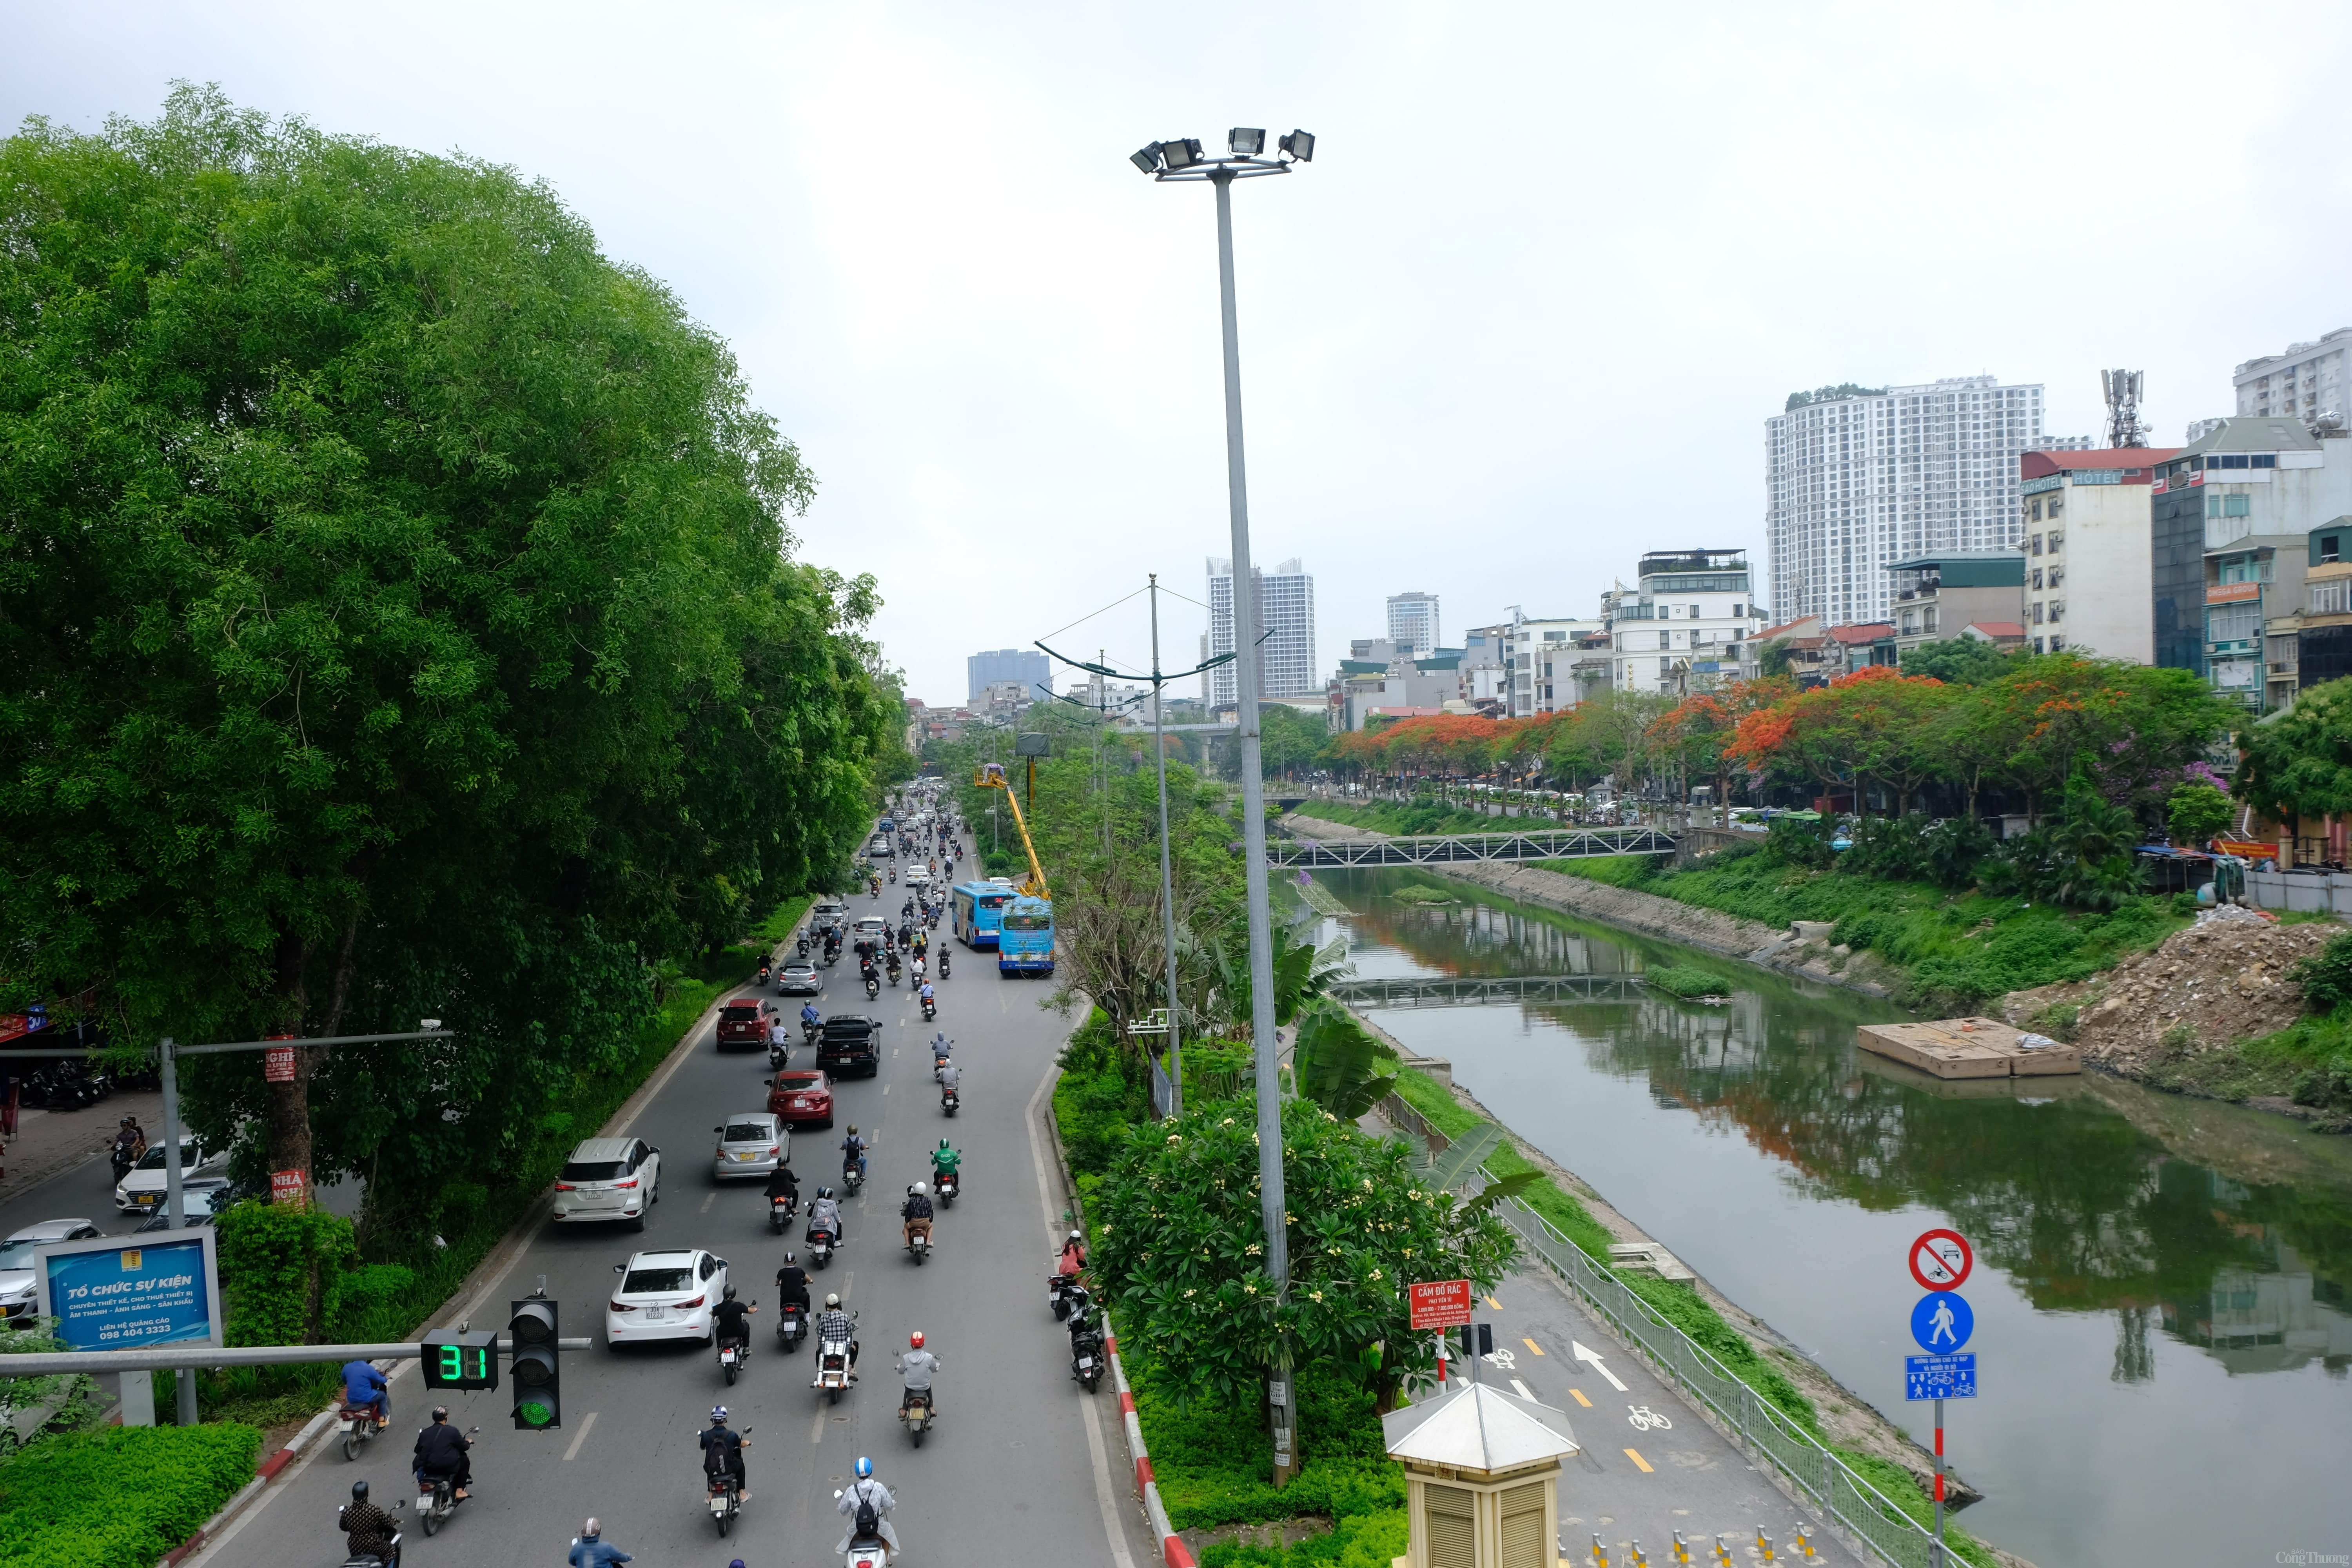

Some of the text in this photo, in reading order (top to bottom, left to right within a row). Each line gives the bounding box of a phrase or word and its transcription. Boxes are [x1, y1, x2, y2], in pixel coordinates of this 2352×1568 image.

[2020, 477, 2060, 494] SAO HOTEL
[2075, 474, 2120, 483] HOTEL
[2207, 584, 2258, 597] OMEGA GROUP
[68, 1274, 192, 1299] TỔ CHỨC SỰ KIỆN
[1418, 1283, 1461, 1297] CẤM ĐỔ RÁC
[69, 1302, 96, 1310] CHUYÊN
[98, 1298, 117, 1306] THIẾT
[100, 1325, 171, 1340] 098 404 3333
[440, 1345, 486, 1379] 31
